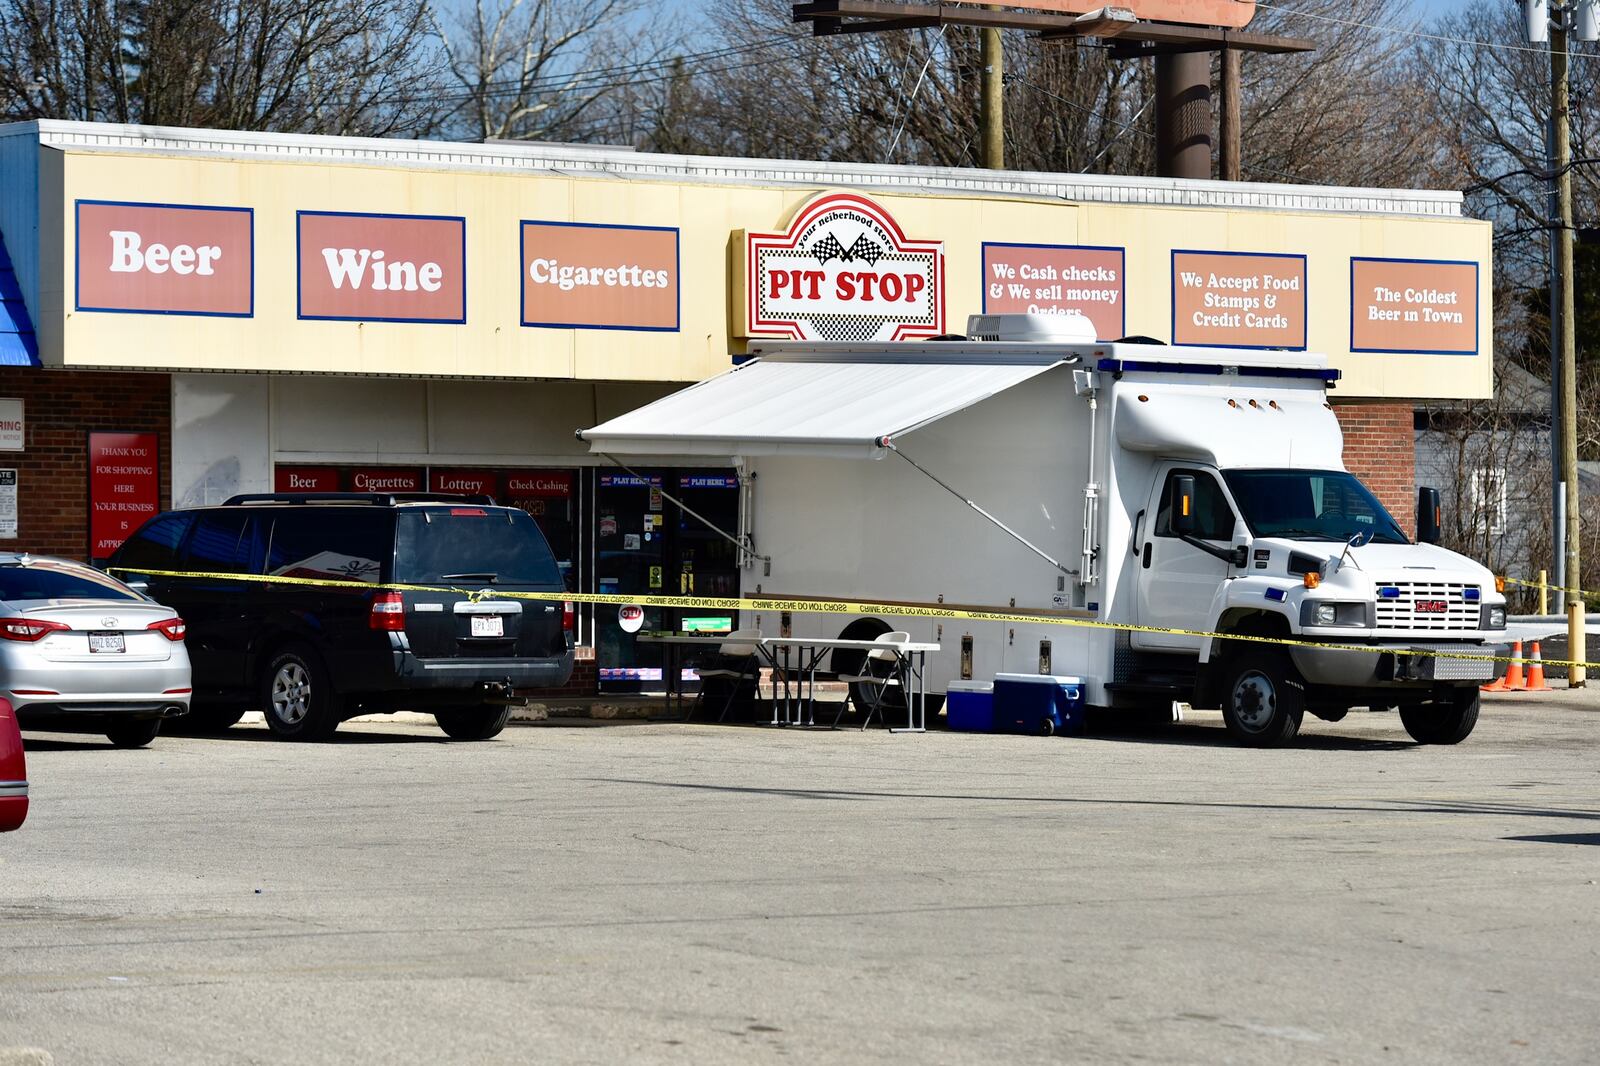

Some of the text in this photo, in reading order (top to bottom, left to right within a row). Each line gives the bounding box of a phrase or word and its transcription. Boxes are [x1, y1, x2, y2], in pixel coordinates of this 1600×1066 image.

[798, 211, 894, 252] your neiberhood store
[108, 230, 222, 275] Beer
[321, 248, 443, 292] Wine
[529, 257, 668, 291] Cigarettes
[992, 263, 1116, 282] We Cash checks
[768, 269, 925, 303] PIT STOP
[1181, 272, 1299, 291] We Accept Food
[990, 283, 1119, 305] & We sell money
[1204, 292, 1276, 310] Stamps &
[1374, 287, 1457, 305] The Coldest
[1192, 312, 1288, 329] Credit Cards
[1368, 306, 1463, 323] Beer in Town
[101, 447, 148, 457] THANK YOU
[96, 466, 153, 475] FOR SHOPPING
[114, 484, 135, 493] HERE
[289, 473, 317, 488] Beer
[354, 473, 415, 492] Cigarettes
[440, 475, 483, 494] Lottery
[509, 479, 568, 493] Check Cashing
[613, 477, 629, 485] PLAY
[691, 478, 706, 486] PLAY
[95, 502, 154, 512] YOUR BUSINESS
[121, 521, 128, 530] IS
[1417, 601, 1448, 612] GMC
